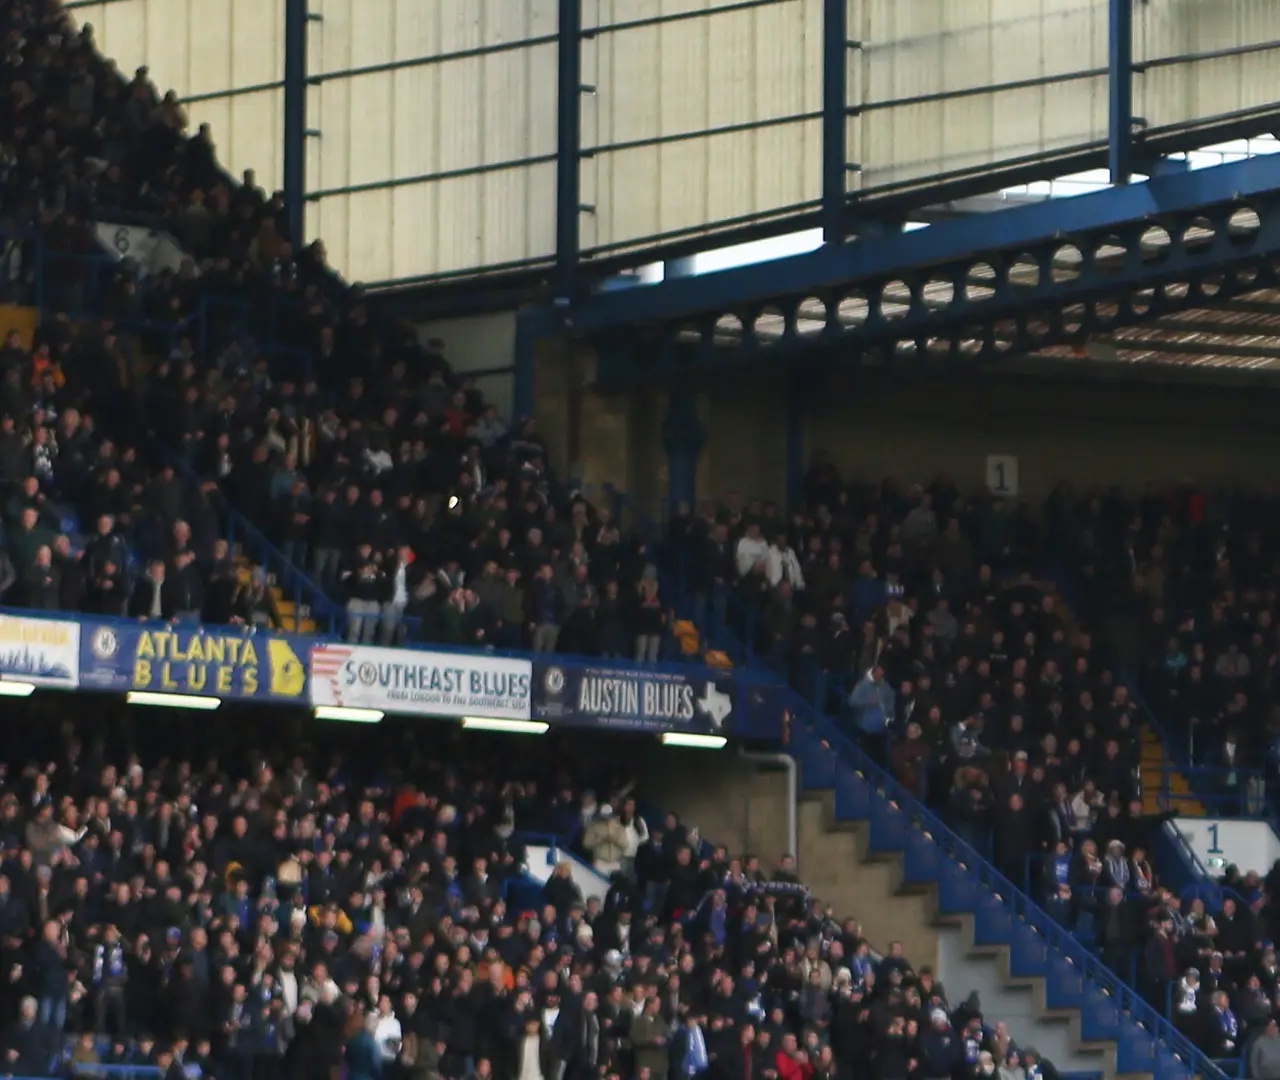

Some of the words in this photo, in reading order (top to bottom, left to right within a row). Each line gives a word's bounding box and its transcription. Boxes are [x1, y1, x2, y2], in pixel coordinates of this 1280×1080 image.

[114, 227, 130, 254] 6
[994, 461, 1010, 492] 1
[137, 631, 258, 664] ATLANTA
[133, 661, 259, 696] BLUES
[345, 662, 465, 695] SOUTHEAST
[470, 668, 531, 699] BLUES
[579, 677, 639, 715] AUSTIN
[644, 682, 695, 720] BLUES
[1207, 822, 1224, 854] 1
